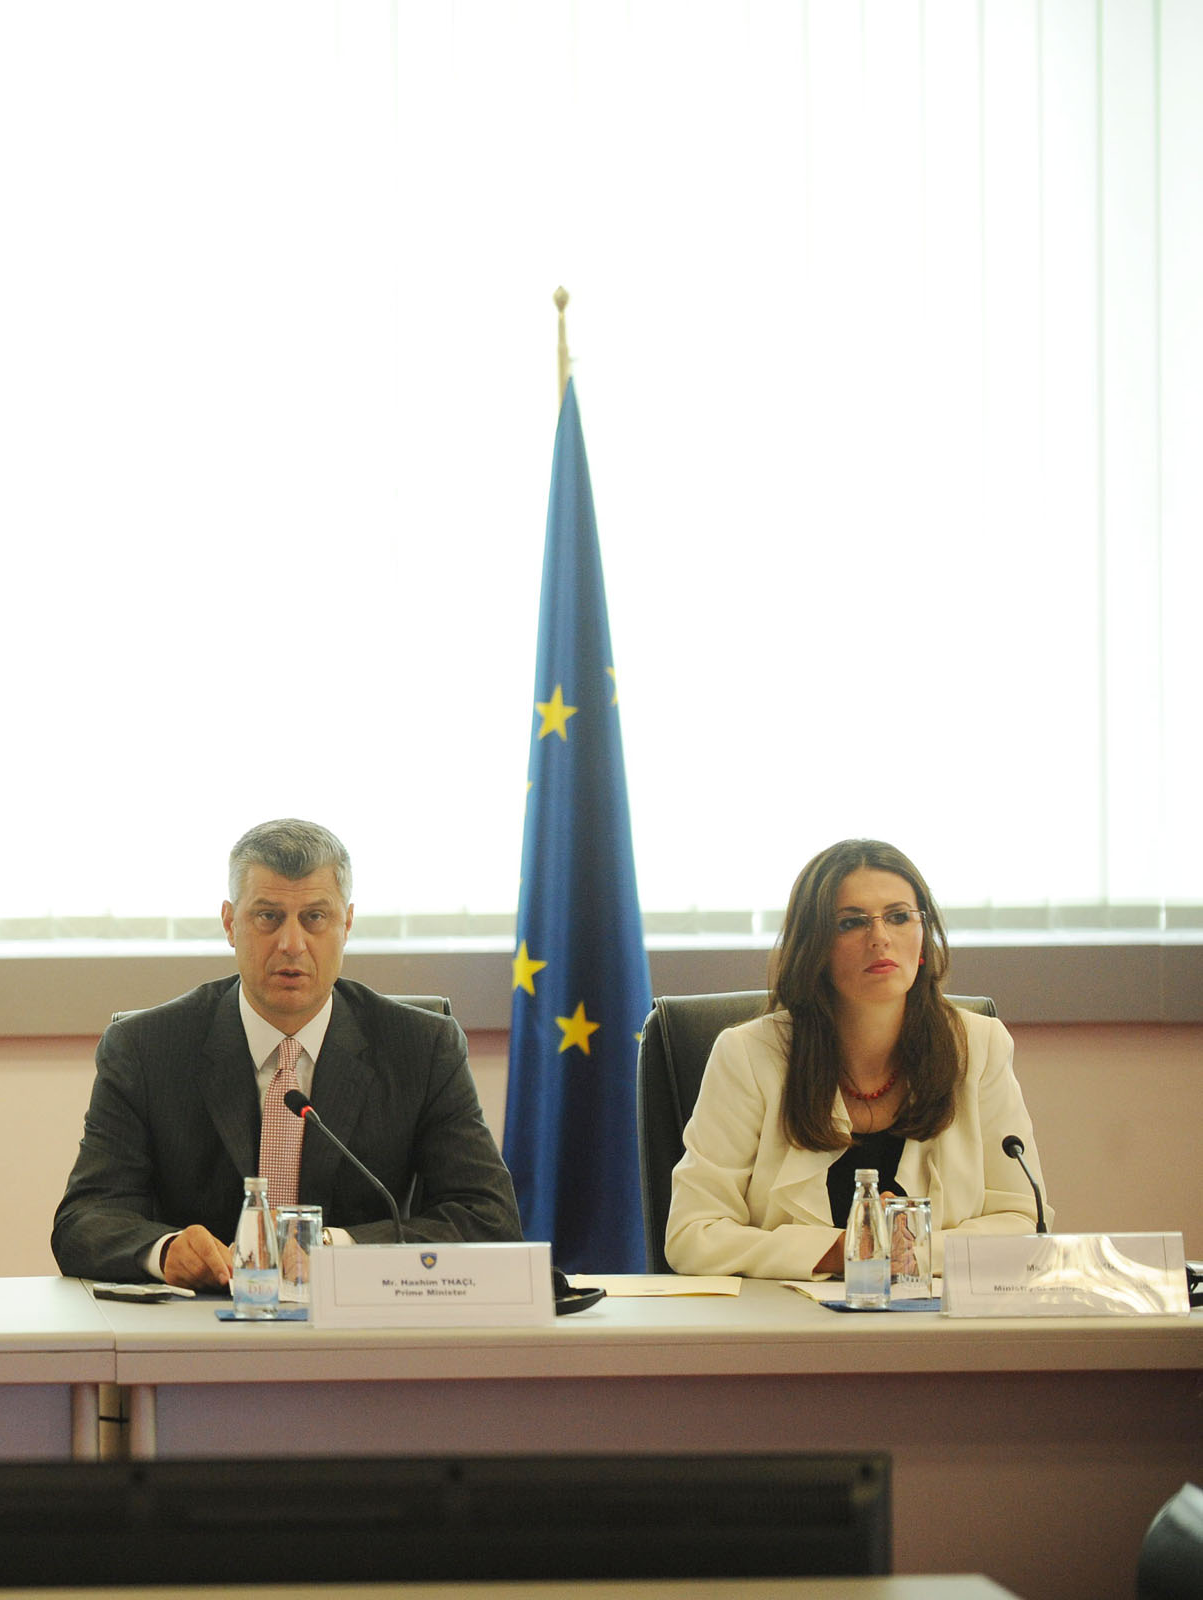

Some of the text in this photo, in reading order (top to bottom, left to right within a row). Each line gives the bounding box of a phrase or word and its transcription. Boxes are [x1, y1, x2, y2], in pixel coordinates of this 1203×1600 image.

[382, 1279, 397, 1287] Mr.
[401, 1279, 438, 1287] Hashim
[395, 1289, 467, 1297] Prime Minister
